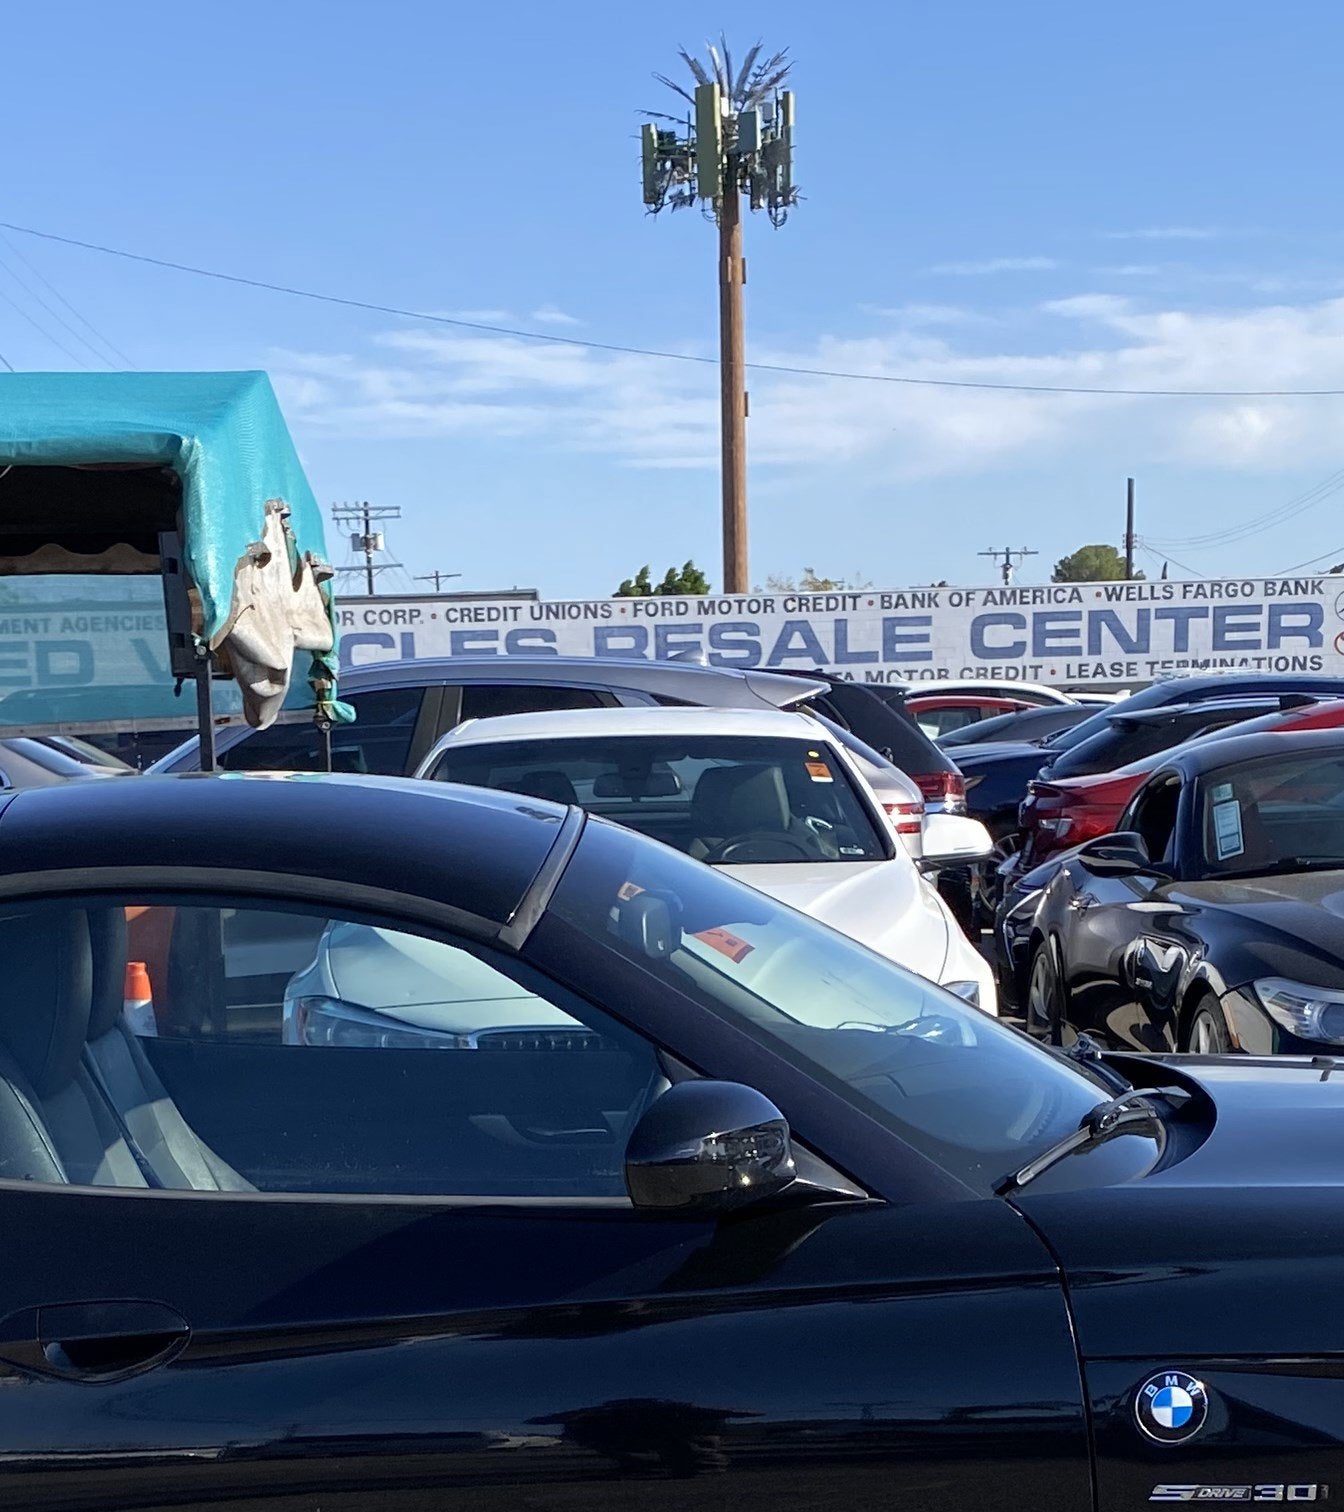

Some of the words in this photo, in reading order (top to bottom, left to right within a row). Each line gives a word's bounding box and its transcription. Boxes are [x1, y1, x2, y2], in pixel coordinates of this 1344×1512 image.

[445, 606, 523, 624] CREDIT
[530, 603, 613, 621] UNIONS
[633, 601, 689, 618] FORD
[697, 598, 776, 616] MOTOR
[783, 595, 861, 613] CREDIT
[880, 592, 940, 610] BANK
[948, 590, 976, 608] OF
[982, 587, 1084, 606] AMERICA
[1104, 584, 1174, 602] WELLS
[1182, 581, 1256, 600] FARGO
[1263, 579, 1325, 597] BANK
[594, 615, 933, 667] RESALE
[970, 602, 1325, 660] CENTER
[865, 667, 950, 684] MOTOR
[960, 664, 1043, 681] CREDIT
[1066, 661, 1138, 679] LEASE
[1146, 655, 1324, 677] TERMINATIONS
[1144, 1374, 1201, 1398] BMW
